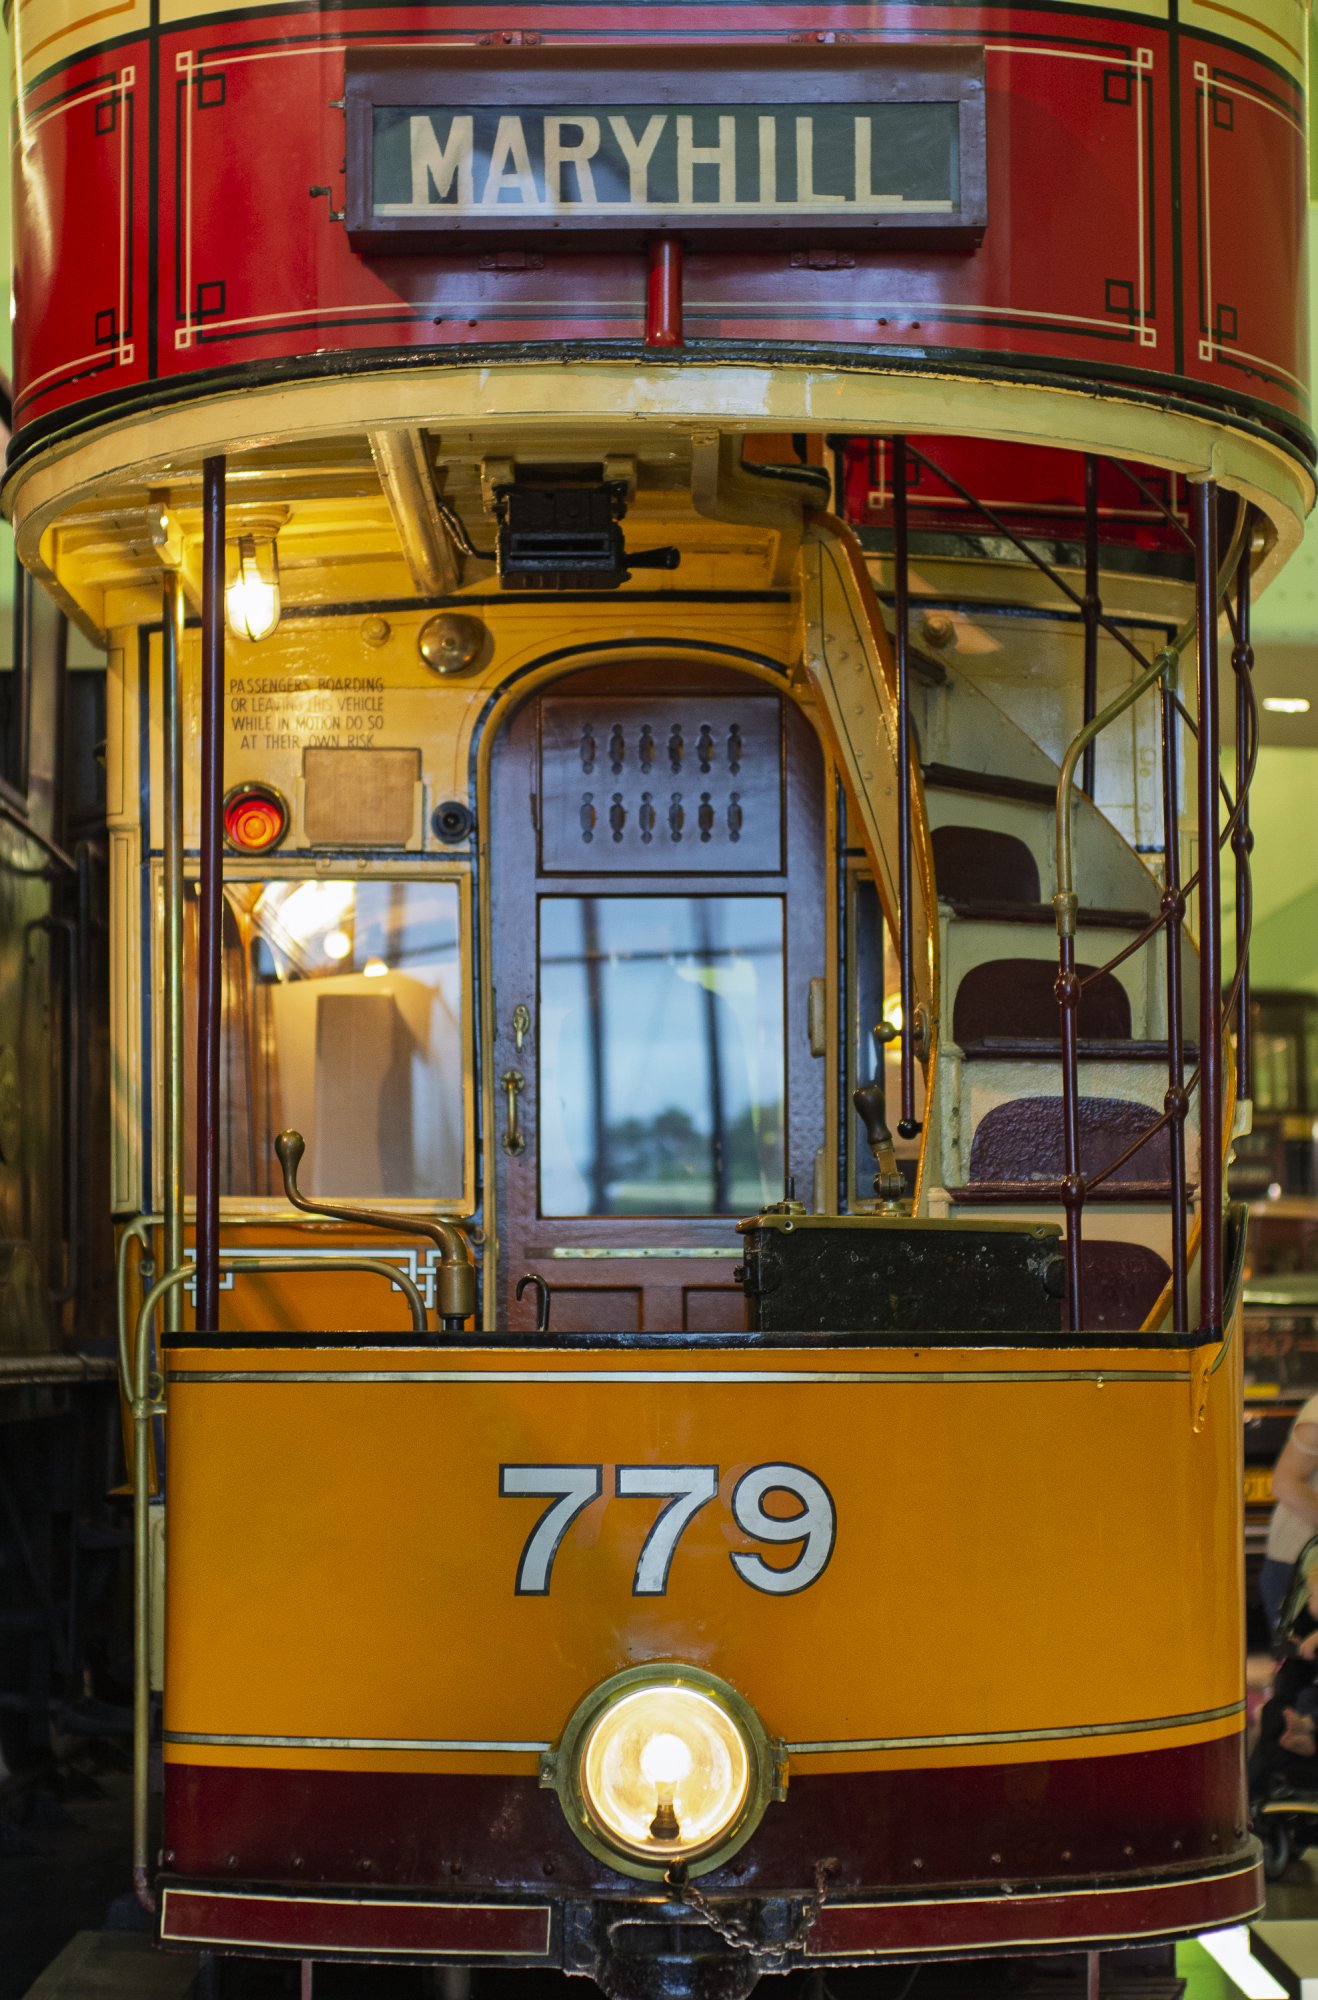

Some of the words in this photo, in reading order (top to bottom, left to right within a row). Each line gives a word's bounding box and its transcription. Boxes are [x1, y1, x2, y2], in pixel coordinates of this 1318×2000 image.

[409, 114, 904, 205] MARYHILL
[229, 678, 311, 694] PASSENGERS
[317, 677, 384, 693] BOARDING
[230, 697, 247, 713] OR
[306, 696, 333, 712] THIS
[339, 697, 384, 712] VEHICLE
[231, 716, 272, 731] WHILE
[278, 716, 289, 731] IN
[296, 715, 340, 731] MOTION
[346, 715, 363, 730] DO
[367, 715, 384, 730] SO
[240, 734, 257, 750] AT
[264, 734, 300, 749] THEIR
[308, 734, 340, 747] OWN
[347, 734, 375, 747] RISK
[499, 1461, 837, 1596] 779
